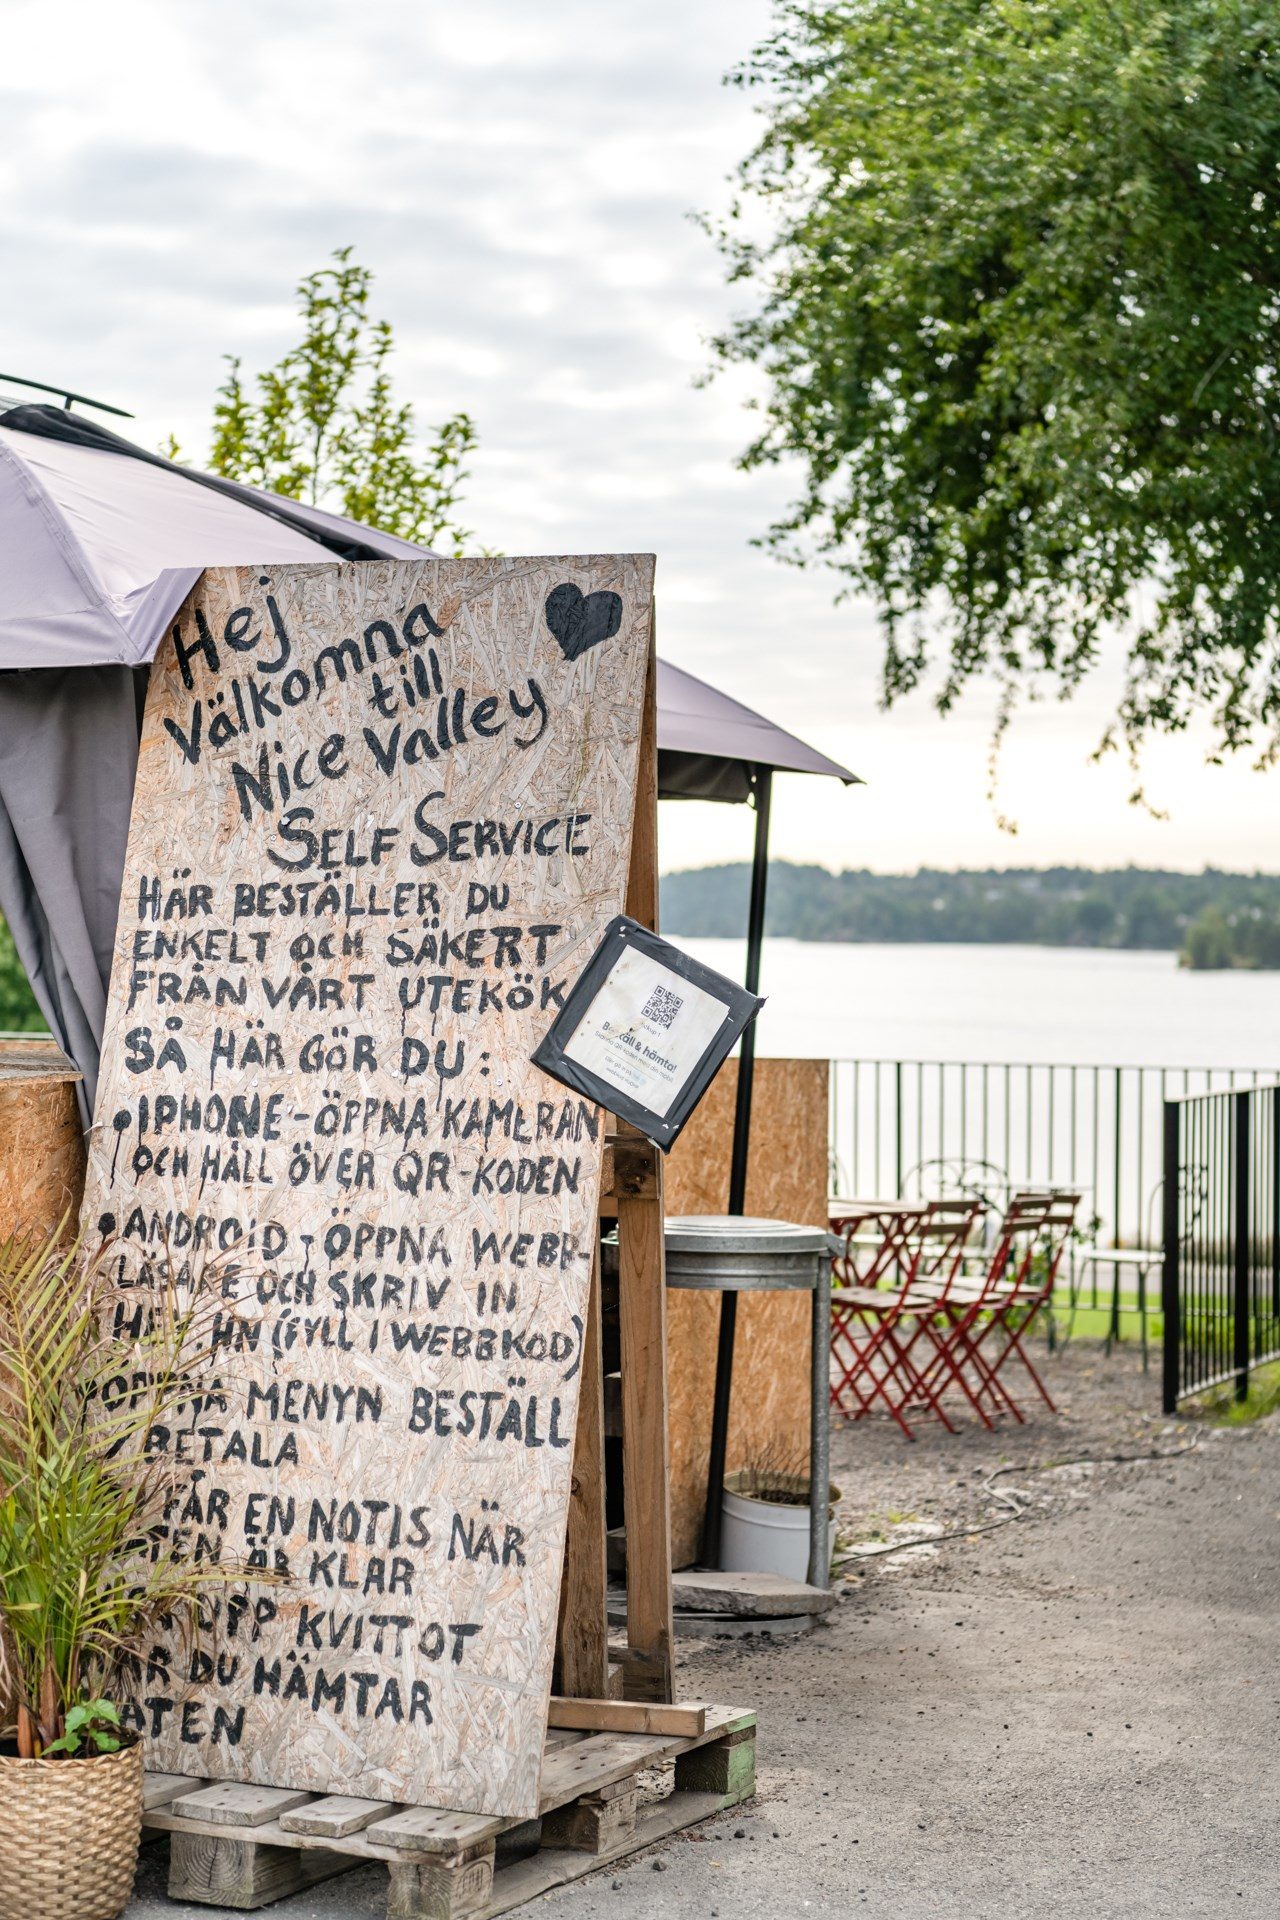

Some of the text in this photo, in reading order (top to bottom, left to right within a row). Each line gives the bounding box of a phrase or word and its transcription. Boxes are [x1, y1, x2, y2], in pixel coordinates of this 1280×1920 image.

[173, 576, 291, 690] Hej
[164, 603, 445, 765] Välkomna
[368, 649, 443, 718] till
[232, 678, 547, 821] Nice Valley
[267, 791, 591, 873] SELF SERVICE
[138, 867, 510, 921] HÄR BESTÄLLER DU
[132, 918, 562, 968] ENKELT OCH SÄKERT
[128, 963, 568, 1013] FRÅN VÅRT UTEKÖK
[124, 1017, 187, 1074] SÅ
[211, 1019, 286, 1073] HÄR
[300, 1027, 378, 1074] GÖR
[633, 1040, 643, 1052] &
[642, 1046, 678, 1072] hämta!
[443, 1098, 600, 1144] KAMERAN
[132, 1143, 189, 1179] OCH
[200, 1141, 273, 1184] HÅLL
[289, 1142, 375, 1189] ÖVER
[256, 1269, 317, 1305] OCH
[327, 1269, 451, 1311] SKRIV
[477, 1281, 517, 1316] IN
[246, 1380, 382, 1425] MENYN
[408, 1376, 571, 1448] BESTÄLL
[243, 1492, 295, 1536] EN
[307, 1499, 432, 1549] NOTIS
[448, 1499, 527, 1568] NÄR
[309, 1549, 414, 1597] KLAR
[297, 1605, 483, 1666] KVITTOT
[190, 1648, 239, 1687] DU
[254, 1649, 434, 1726] HÄMTAR
